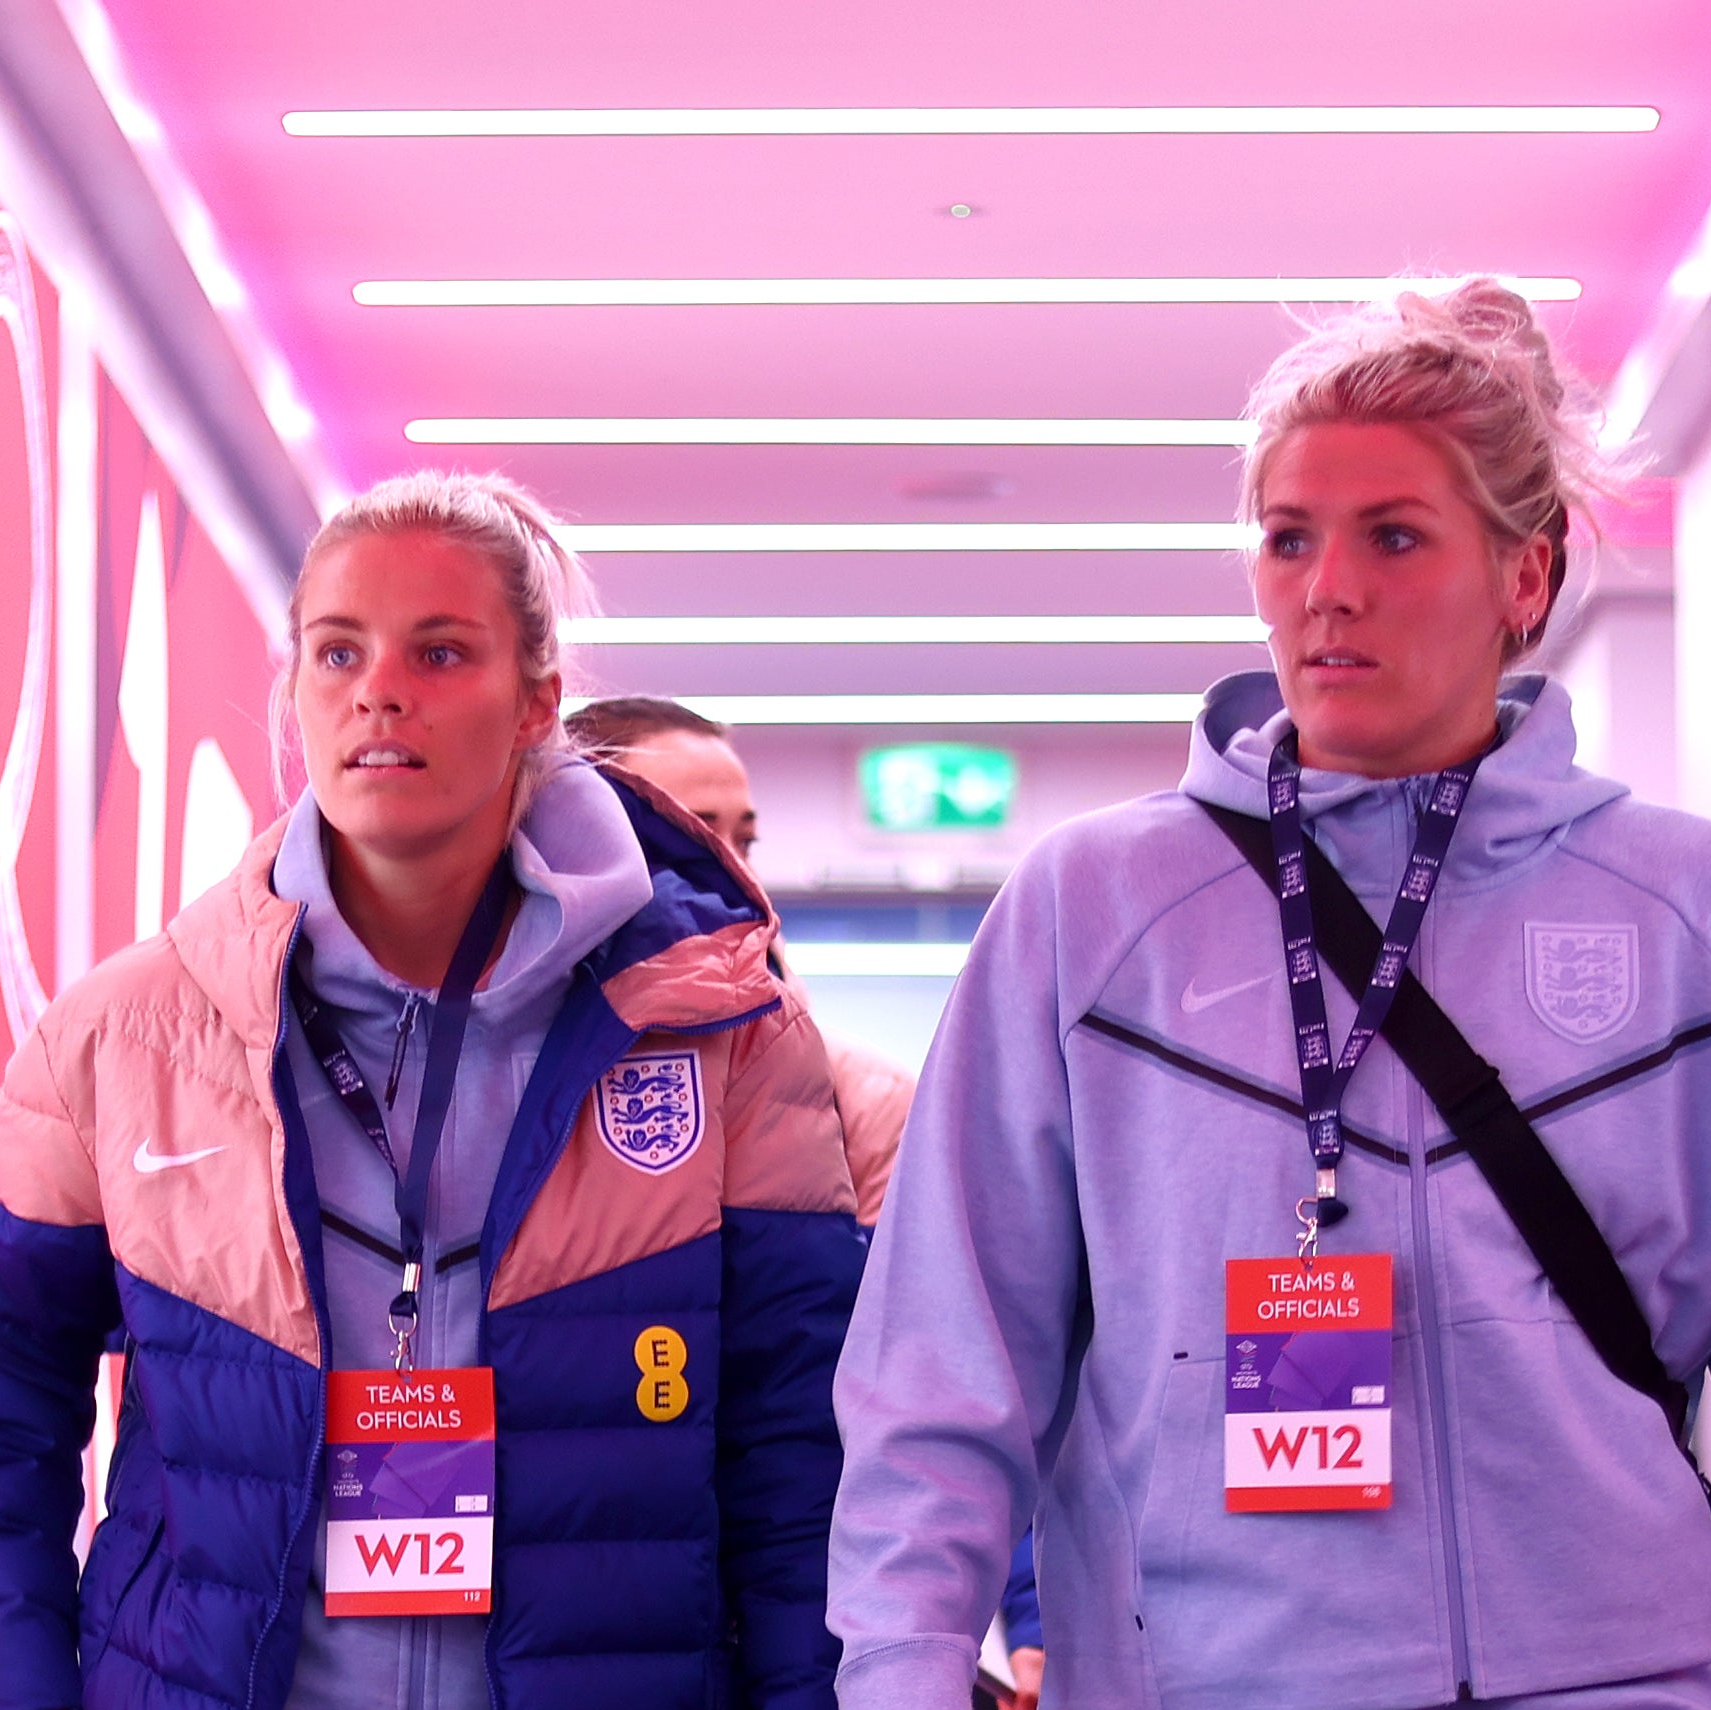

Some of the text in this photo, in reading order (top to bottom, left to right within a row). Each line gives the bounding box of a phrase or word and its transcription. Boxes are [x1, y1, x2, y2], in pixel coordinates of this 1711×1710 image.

[1268, 1272, 1356, 1293] TEAMS &
[1257, 1297, 1360, 1320] OFFICIALS
[365, 1385, 456, 1404] TEAMS &
[356, 1409, 462, 1431] OFFICIALS
[1253, 1424, 1364, 1472] W12
[354, 1531, 465, 1577] W12
